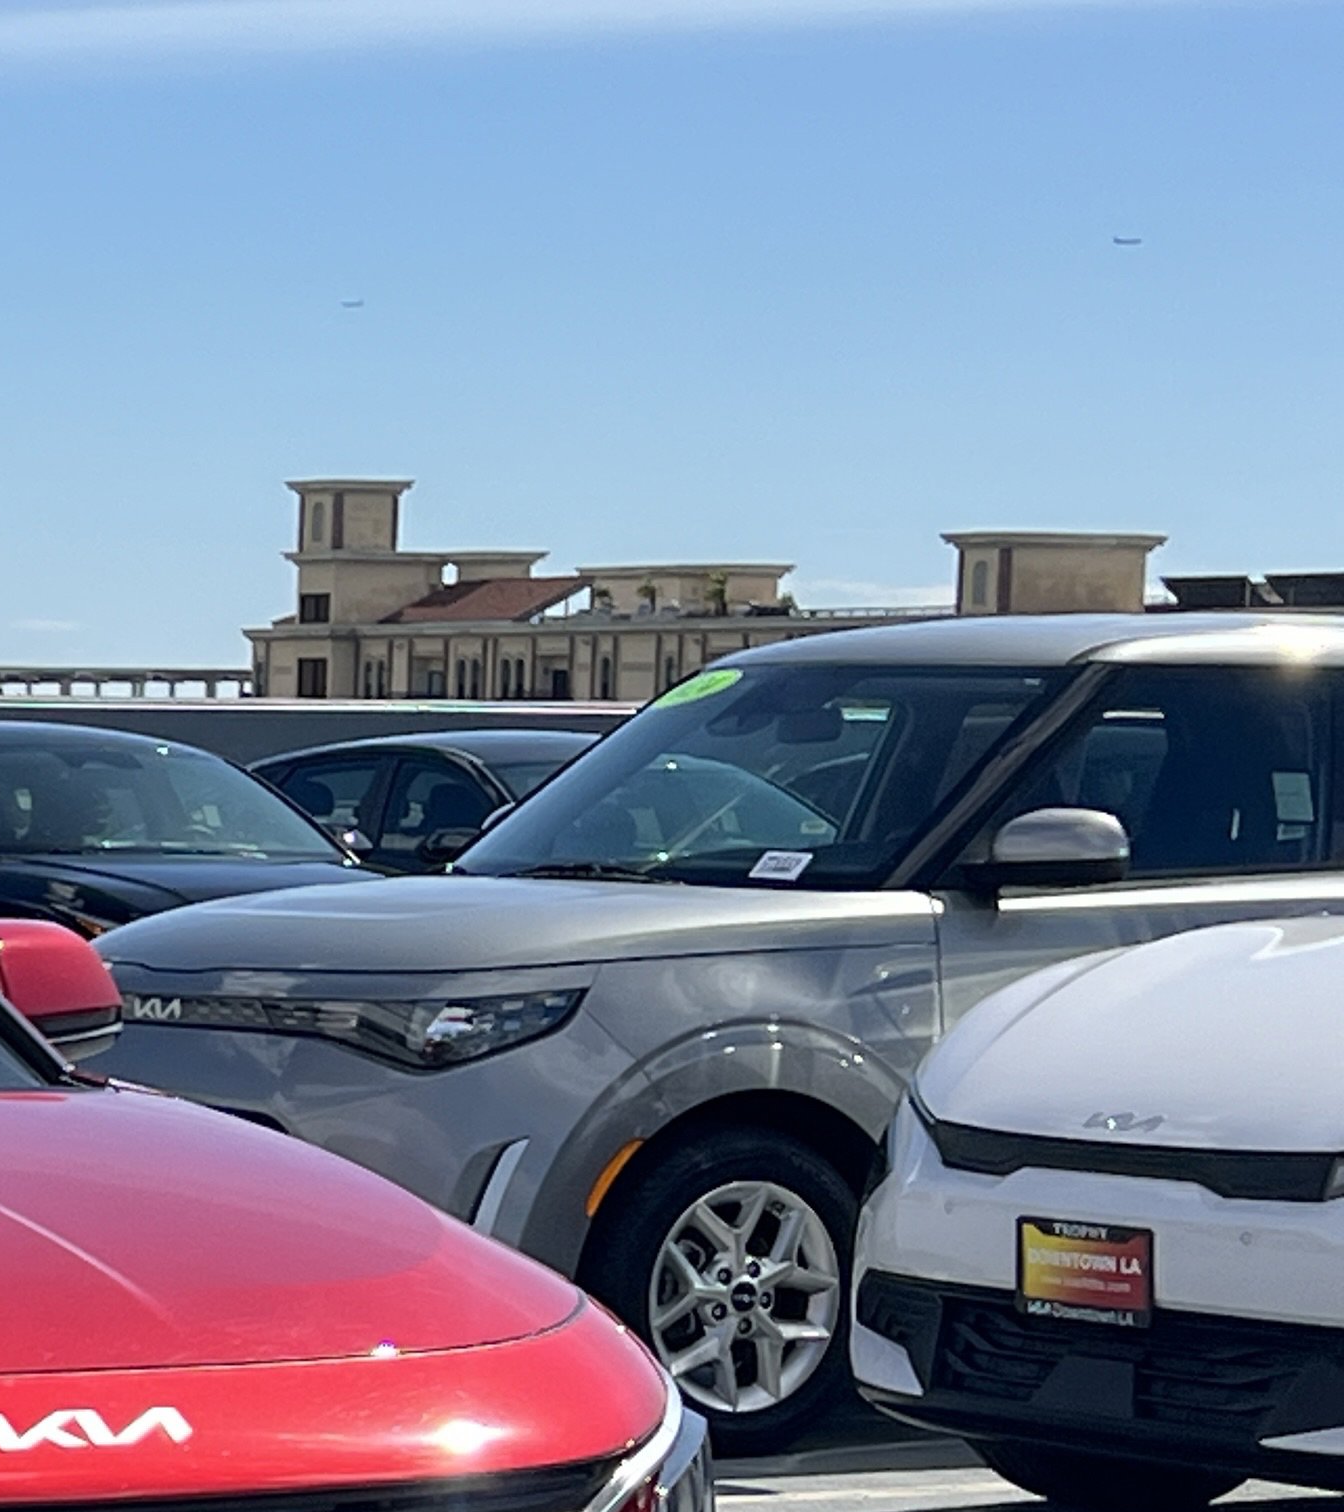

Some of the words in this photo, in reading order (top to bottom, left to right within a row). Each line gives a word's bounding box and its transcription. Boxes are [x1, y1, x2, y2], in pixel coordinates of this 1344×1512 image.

[133, 997, 182, 1020] KIA
[1052, 1222, 1109, 1240] TROPHY
[1119, 1256, 1142, 1275] LA
